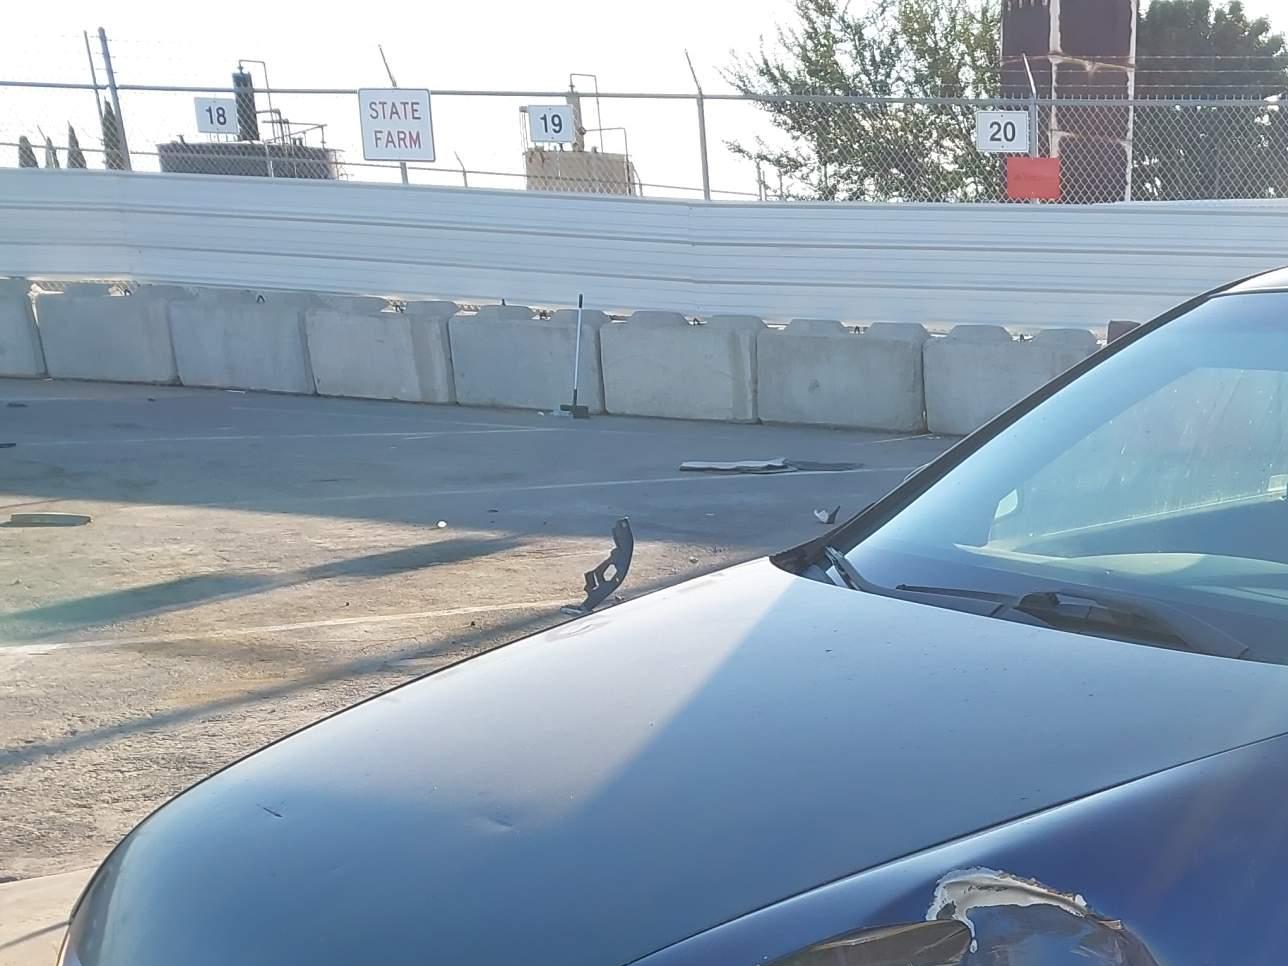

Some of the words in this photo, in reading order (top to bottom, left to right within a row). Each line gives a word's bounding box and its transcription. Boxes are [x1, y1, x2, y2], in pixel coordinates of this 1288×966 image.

[205, 106, 227, 126] 18
[369, 101, 422, 120] STATE
[540, 113, 563, 134] 19
[989, 121, 1016, 142] 20
[374, 130, 422, 149] FARM
